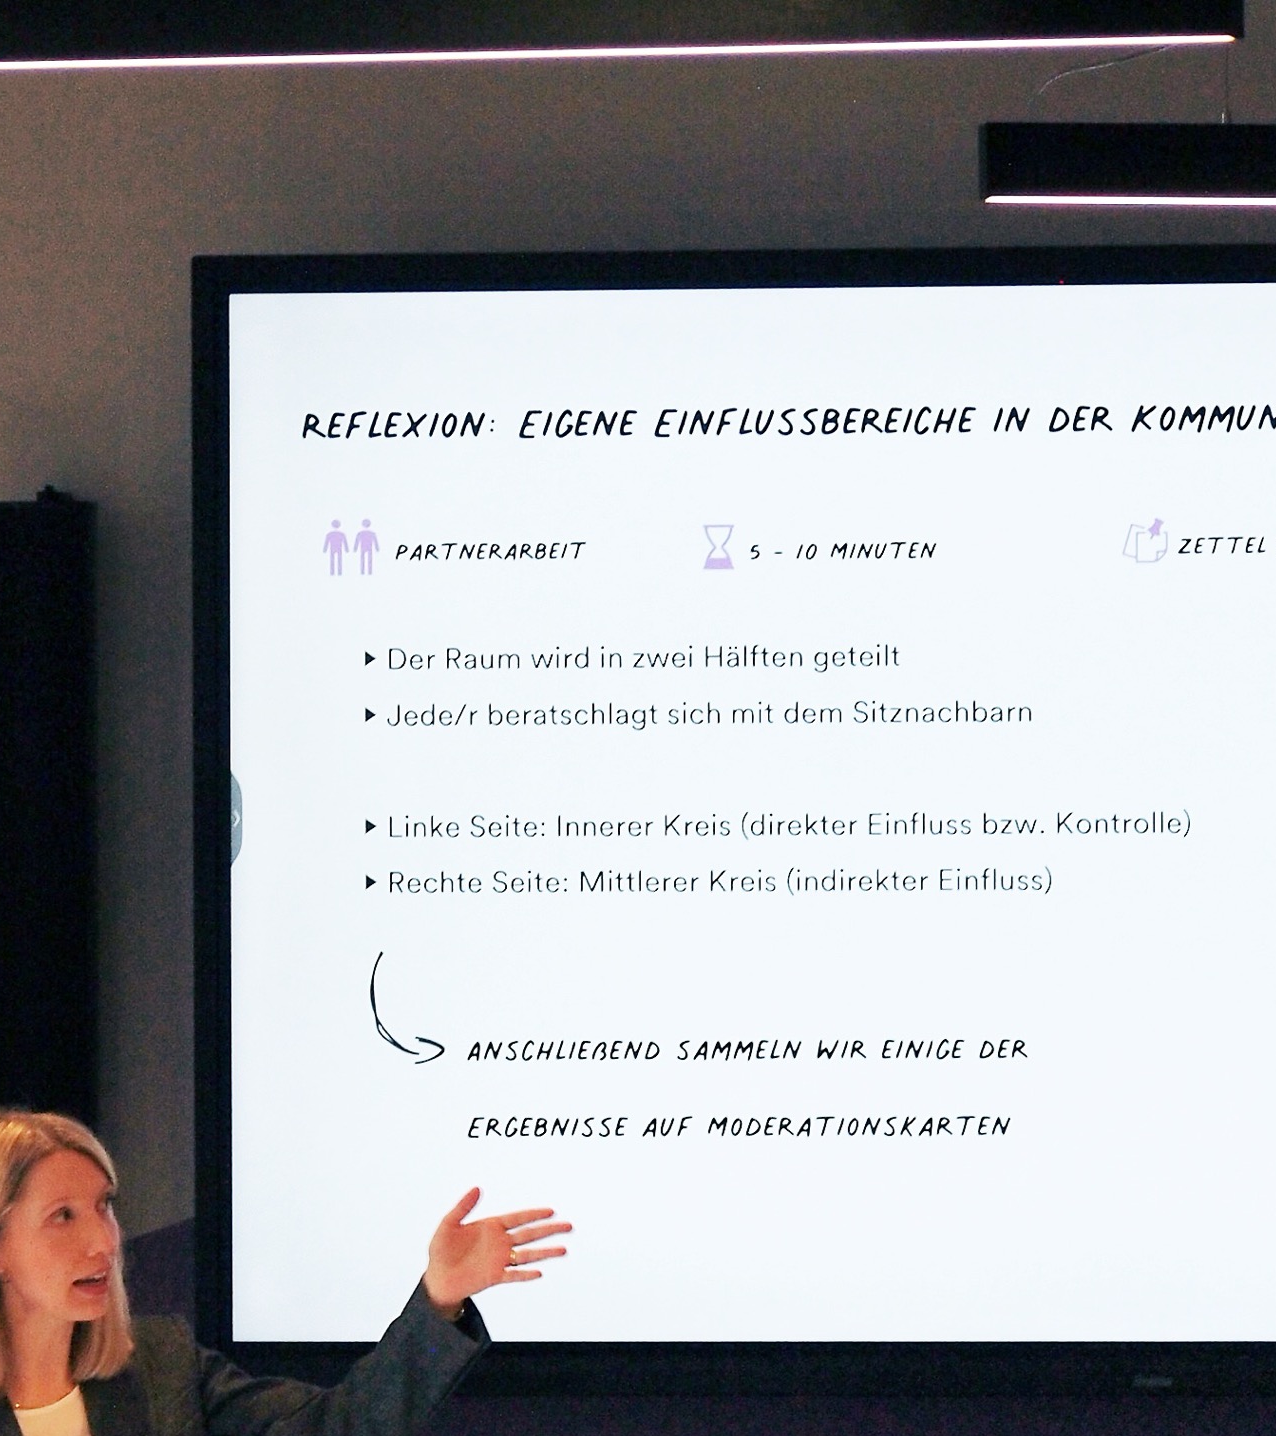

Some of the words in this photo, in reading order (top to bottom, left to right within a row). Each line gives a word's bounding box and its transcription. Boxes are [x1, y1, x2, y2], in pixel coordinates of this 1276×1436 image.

[300, 409, 496, 441] REFLEXION:
[517, 407, 639, 441] EIGENE
[652, 404, 978, 439] EINFLUSSBEREICHE
[991, 405, 1032, 434] IN
[1047, 404, 1115, 434] DER
[394, 540, 588, 563] PARTNERARBEIT
[749, 543, 762, 562] 5
[794, 542, 819, 562] 10
[829, 540, 938, 561] MINUTEN
[1176, 534, 1267, 556] ZETTEL
[387, 646, 437, 672] Der
[445, 646, 522, 671] Raum
[529, 644, 591, 671] wird
[599, 644, 624, 670] in
[631, 643, 694, 670] zwei
[703, 643, 804, 670] Hälften
[812, 642, 901, 675] geteilt
[385, 702, 479, 728] Jede/r
[487, 701, 659, 732] beratschlagt
[666, 700, 722, 727] sich
[731, 699, 775, 725] mit
[782, 700, 844, 726] dem
[852, 698, 1033, 725] Sitznachbarn
[388, 813, 461, 840] Linke
[469, 813, 546, 840] Seite:
[556, 813, 655, 839] Innerer
[663, 812, 732, 838] Kreis
[740, 810, 859, 841] (direkter
[867, 810, 973, 837] Einfluss
[981, 811, 1046, 836] bzw.
[1055, 807, 1192, 839] Kontrolle)
[388, 869, 483, 895] Rechte
[491, 869, 569, 895] Seite:
[579, 868, 701, 894] Mittlerer
[709, 867, 778, 894] Kreis
[785, 865, 930, 897] (indirekter
[938, 865, 1053, 896] Einfluss)
[675, 1038, 804, 1063] SAMMELN
[815, 1038, 868, 1061] WIR
[880, 1037, 967, 1062] EINIGE
[977, 1037, 1030, 1061] DER
[466, 1115, 630, 1140] ERGEBNISSE
[640, 1114, 695, 1139] AUF
[706, 1114, 1013, 1139] MODERATIONSKARTEN
